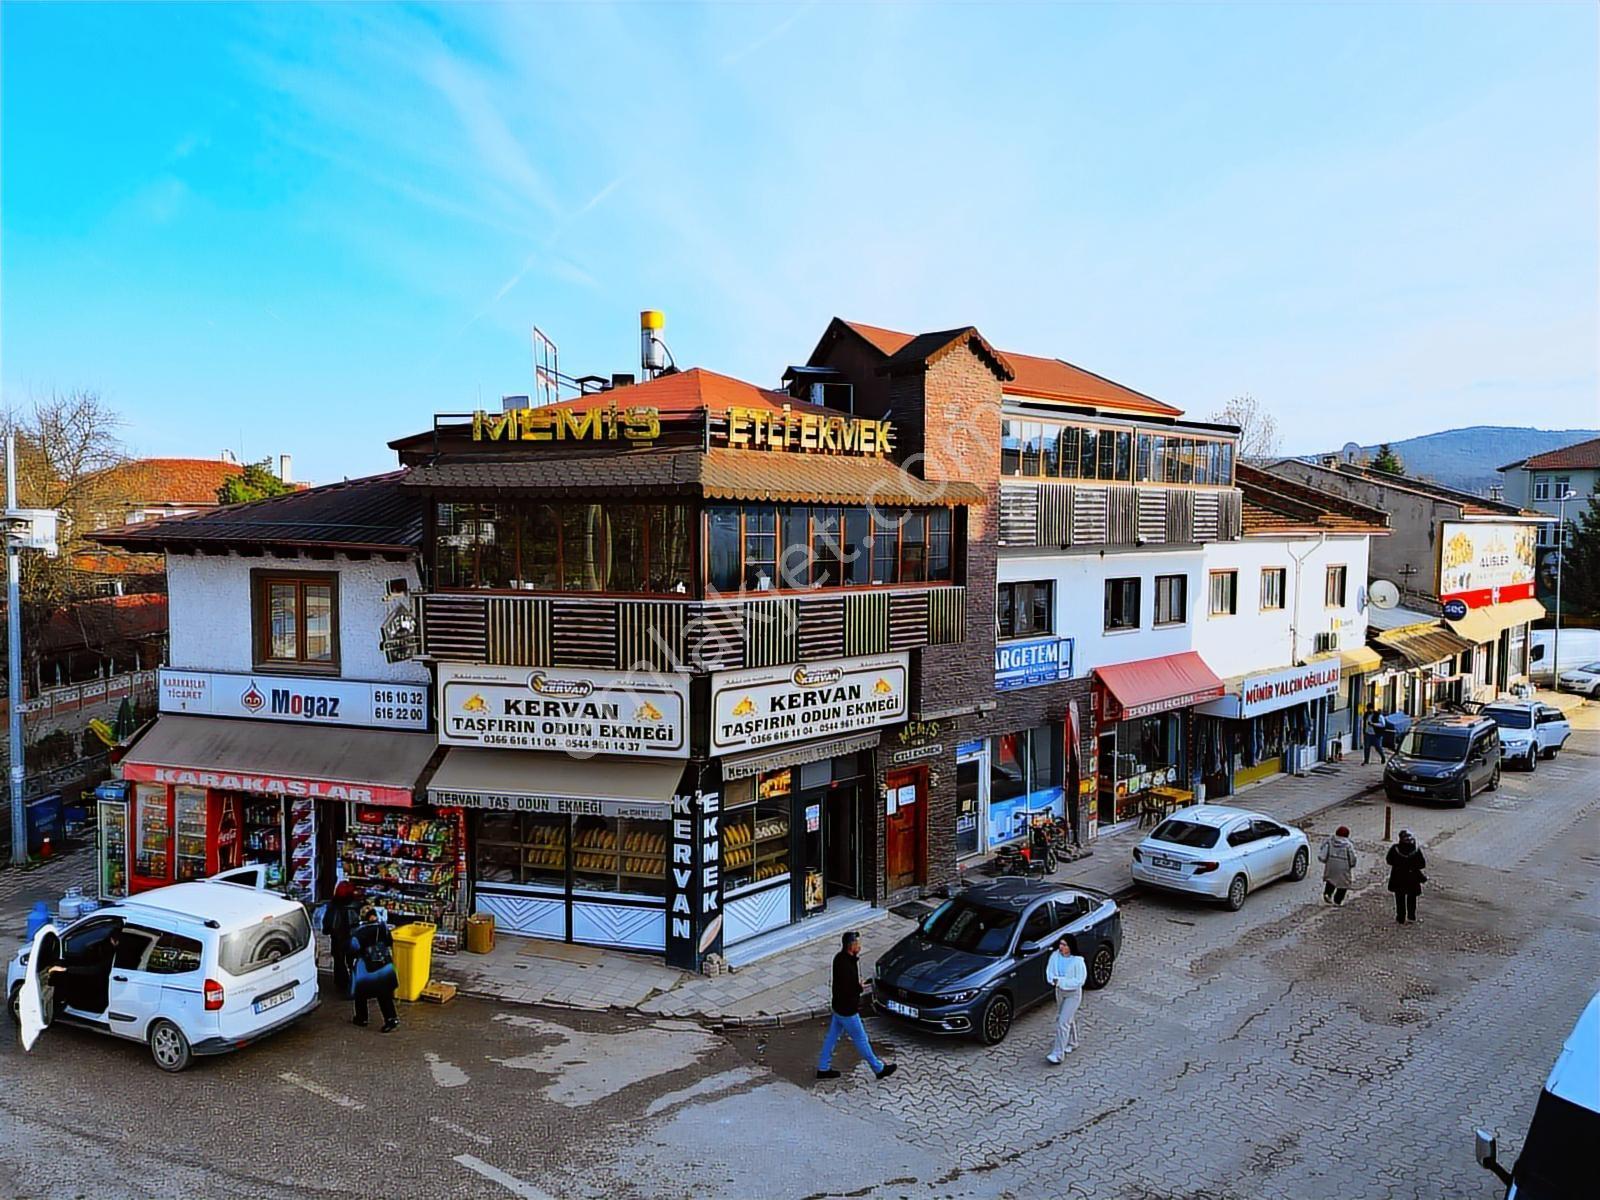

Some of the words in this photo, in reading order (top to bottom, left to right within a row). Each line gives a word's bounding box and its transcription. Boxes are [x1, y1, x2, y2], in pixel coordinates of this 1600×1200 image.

[472, 400, 661, 447] MEMİŞ
[729, 402, 792, 447] ETLİ
[800, 412, 893, 453] EKMEK
[374, 690, 393, 703] 616
[396, 691, 408, 704] 10
[410, 692, 423, 705] 32
[540, 684, 588, 695] KERVAN
[770, 685, 862, 712] KERVAN
[1246, 681, 1273, 706] MÜNİR
[1275, 676, 1303, 698] YALÇIN
[1304, 668, 1339, 690] OĞULLARI
[271, 689, 340, 718] Mogaz
[374, 707, 393, 719] 616
[396, 708, 408, 720] 22
[410, 708, 423, 720] 00
[504, 698, 618, 720] KERVAN
[722, 713, 796, 738] TAŞFIRIN
[801, 706, 841, 724] ODUN
[846, 695, 899, 717] EKMEĞİ
[452, 717, 535, 735] TAŞFIRIN
[542, 721, 592, 737] ODUN
[600, 724, 674, 741] EKMEĞİ
[484, 735, 507, 744] 0366
[510, 736, 528, 745] 616
[531, 737, 541, 746] 11
[545, 738, 557, 747] 04
[565, 739, 588, 749] 0544
[614, 741, 625, 750] 14
[628, 742, 640, 751] 37
[751, 735, 772, 745] 0366
[774, 731, 789, 740] 616
[792, 729, 800, 737] 11
[803, 726, 812, 735] 04
[820, 722, 838, 732] 0544
[857, 717, 865, 726] 14
[867, 715, 875, 724] 37
[436, 791, 481, 806] KERVAN
[517, 797, 549, 810] ODUN
[673, 794, 692, 939] KERVAN
[703, 791, 719, 914] EKMEK
